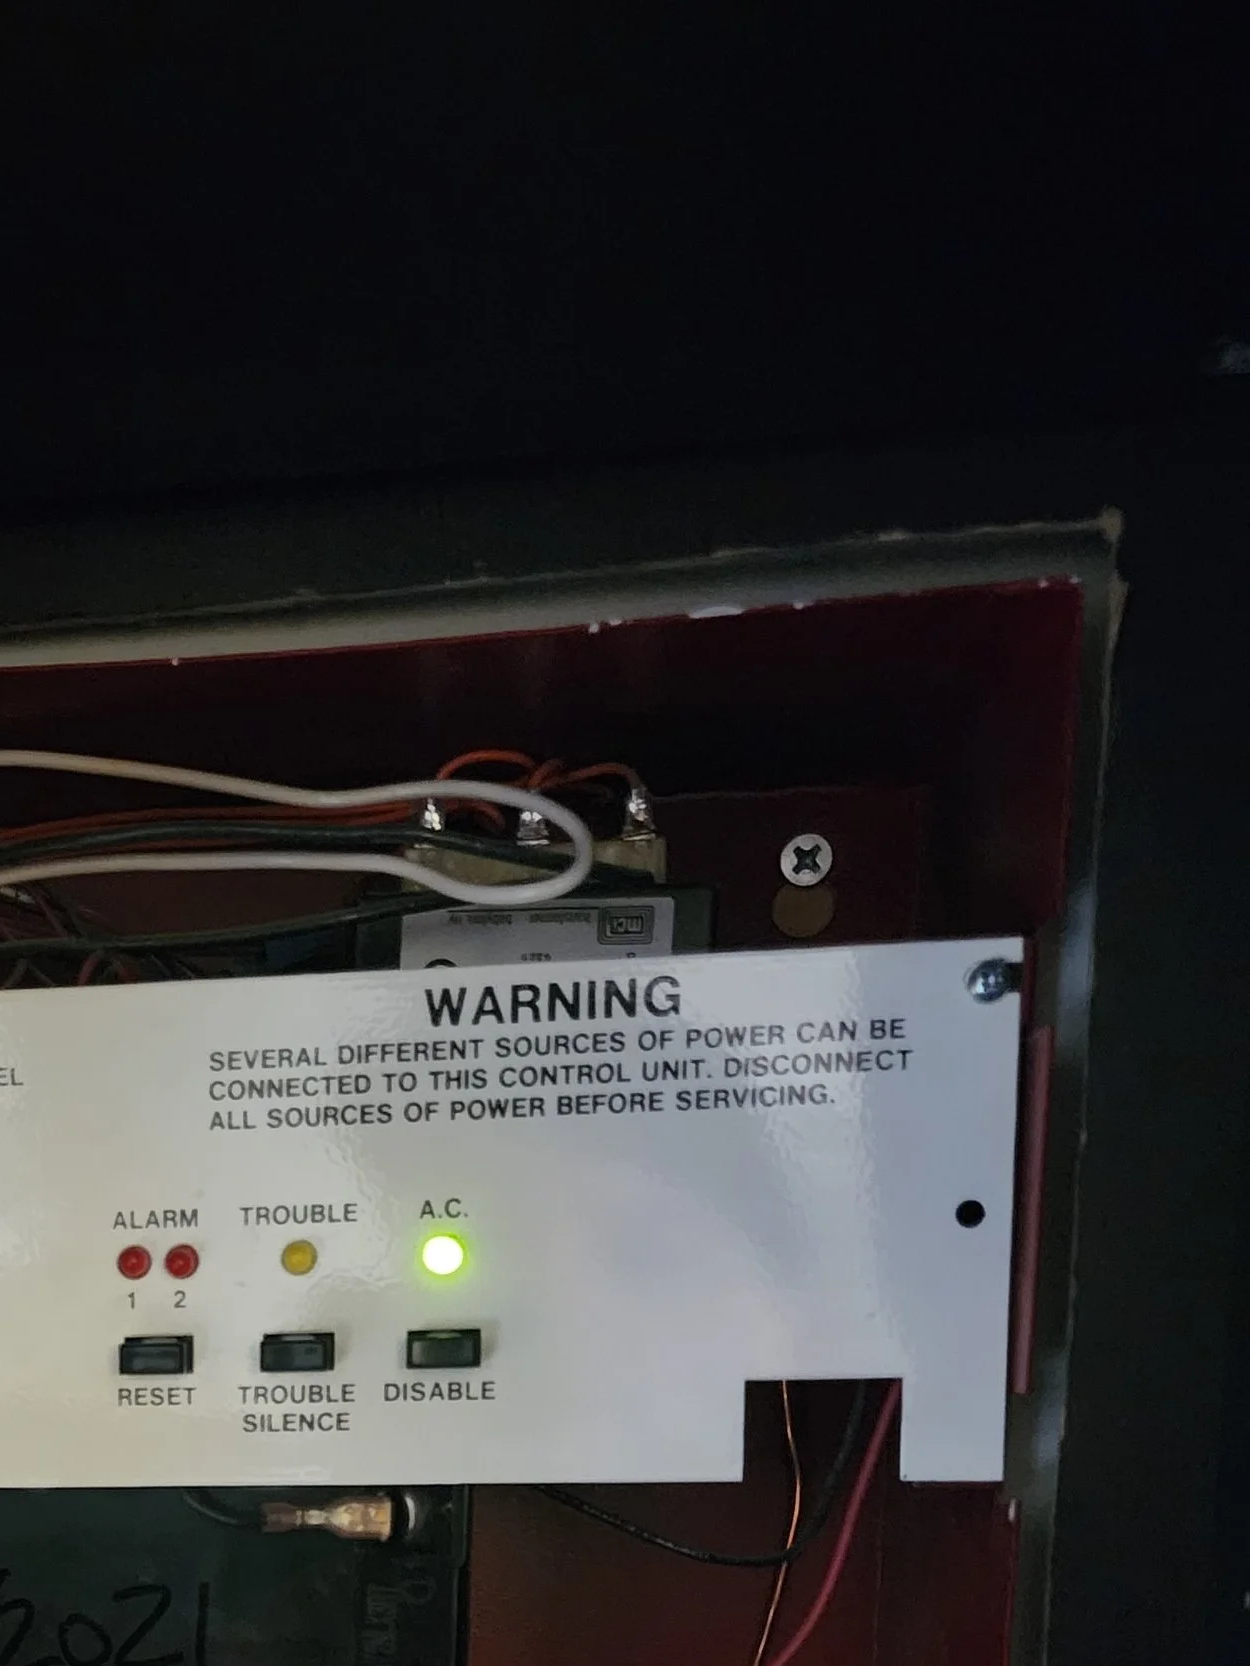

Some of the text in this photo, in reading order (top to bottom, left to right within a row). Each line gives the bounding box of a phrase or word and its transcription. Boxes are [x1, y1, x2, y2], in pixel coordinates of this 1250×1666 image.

[424, 975, 681, 1027] WARNING
[209, 1018, 906, 1072] SEVERAL DIFFERENT SOURCES OF POWER CAN BE
[209, 1049, 914, 1101] CONNECTED TO THIS CONTROL UNIT. DISCONNECT
[209, 1083, 835, 1132] ALL SOURCES OF POWER BEFORE SERVICING.
[113, 1208, 199, 1229] ALARM
[240, 1203, 358, 1226] TROUBLE
[419, 1198, 469, 1219] A.C.
[127, 1290, 187, 1310] 1 2
[117, 1386, 197, 1407] RESET
[238, 1383, 356, 1404] TROUBLE
[384, 1381, 497, 1402] DISABLE
[242, 1412, 351, 1433] SILENCE
